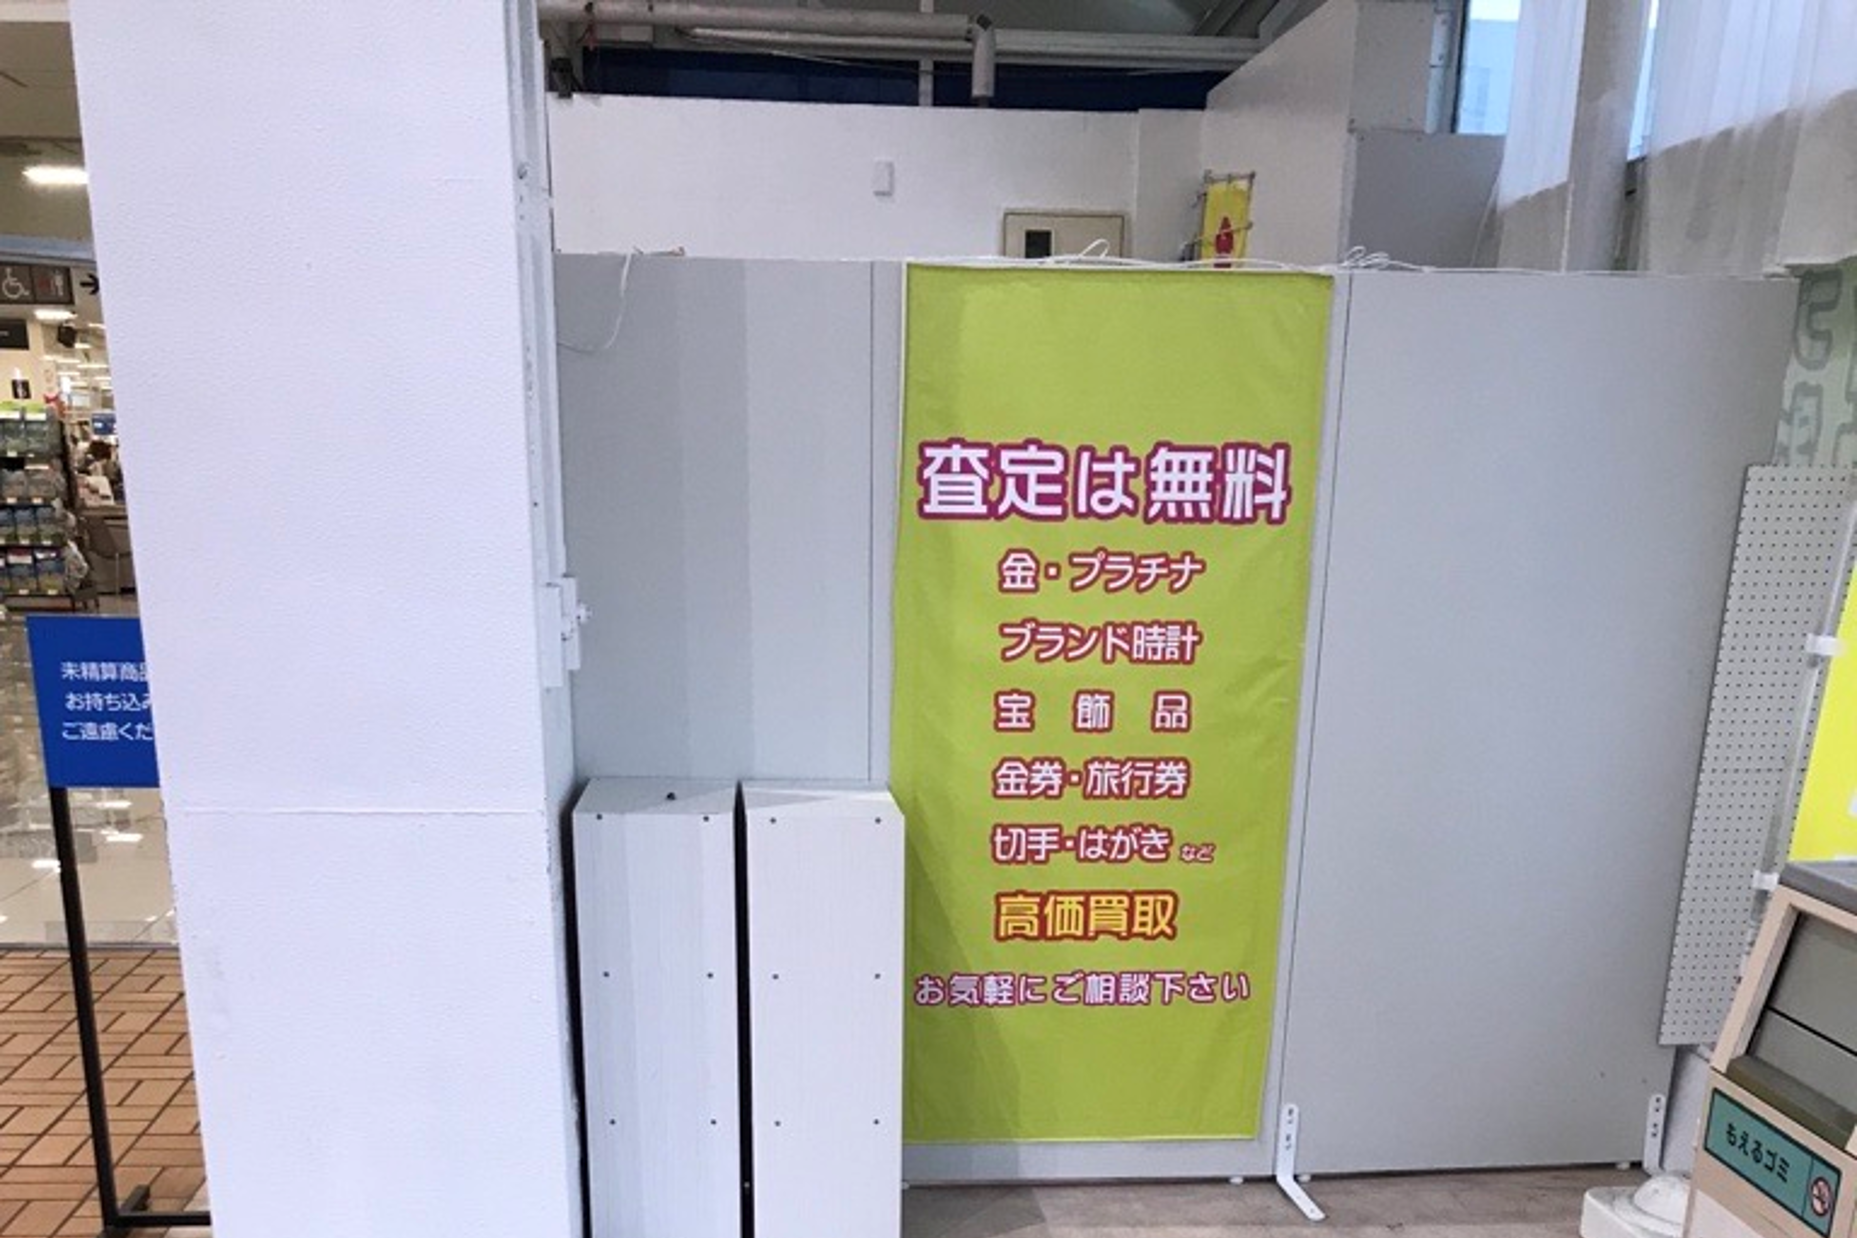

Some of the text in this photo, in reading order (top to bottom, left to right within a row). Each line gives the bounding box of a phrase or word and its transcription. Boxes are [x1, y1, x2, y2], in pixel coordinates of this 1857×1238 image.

[918, 438, 1291, 525] 査定は無料
[998, 547, 1206, 593] 金・プラチナ
[998, 618, 1204, 664] ブランド時計
[991, 757, 1191, 799] 金券・旅行券
[991, 823, 1217, 864] 切手・はがき など
[994, 890, 1180, 940] 高価買取
[914, 970, 1252, 1007] お気軽にご相談下さい
[1725, 1123, 1790, 1184] もえるゴミ
